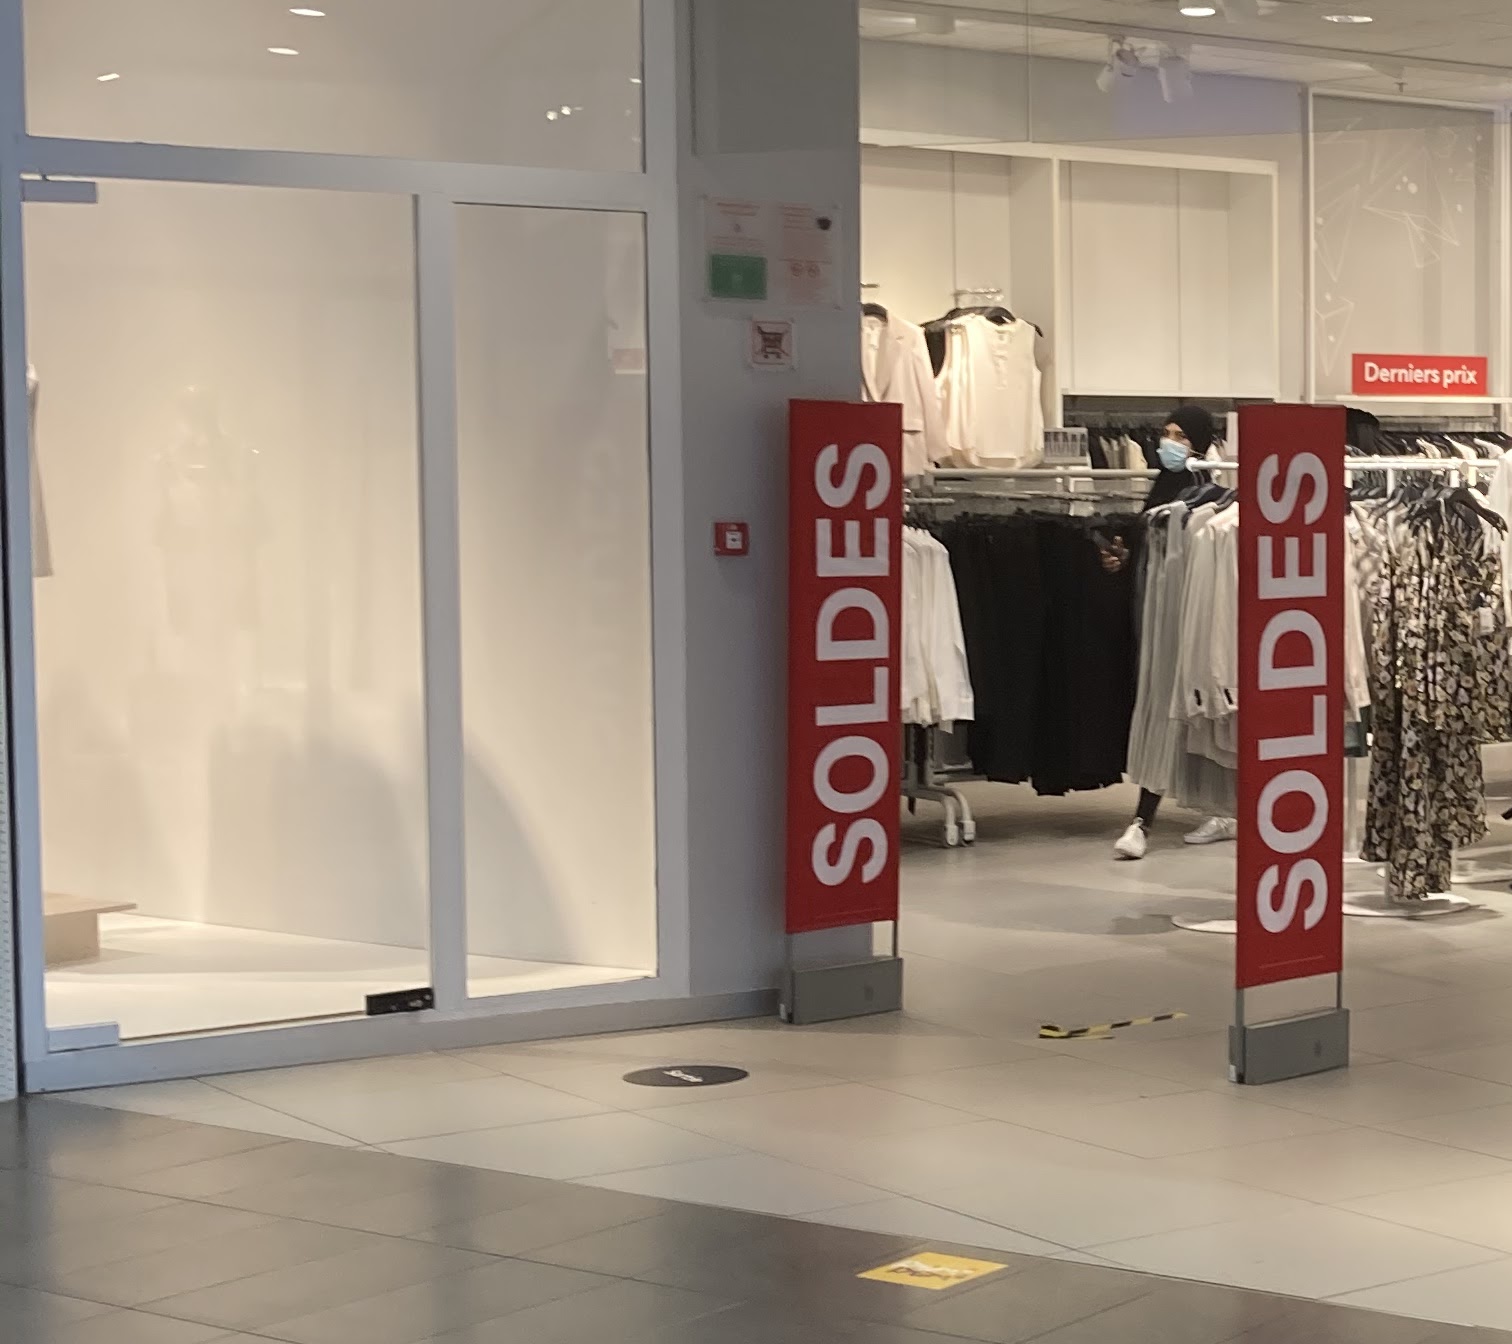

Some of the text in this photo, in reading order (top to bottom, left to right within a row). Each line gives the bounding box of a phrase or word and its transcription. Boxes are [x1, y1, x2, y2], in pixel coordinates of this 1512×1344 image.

[1363, 362, 1479, 389] Derniers prix
[812, 443, 892, 886] SOLDES
[1256, 452, 1329, 934] SOLDES
